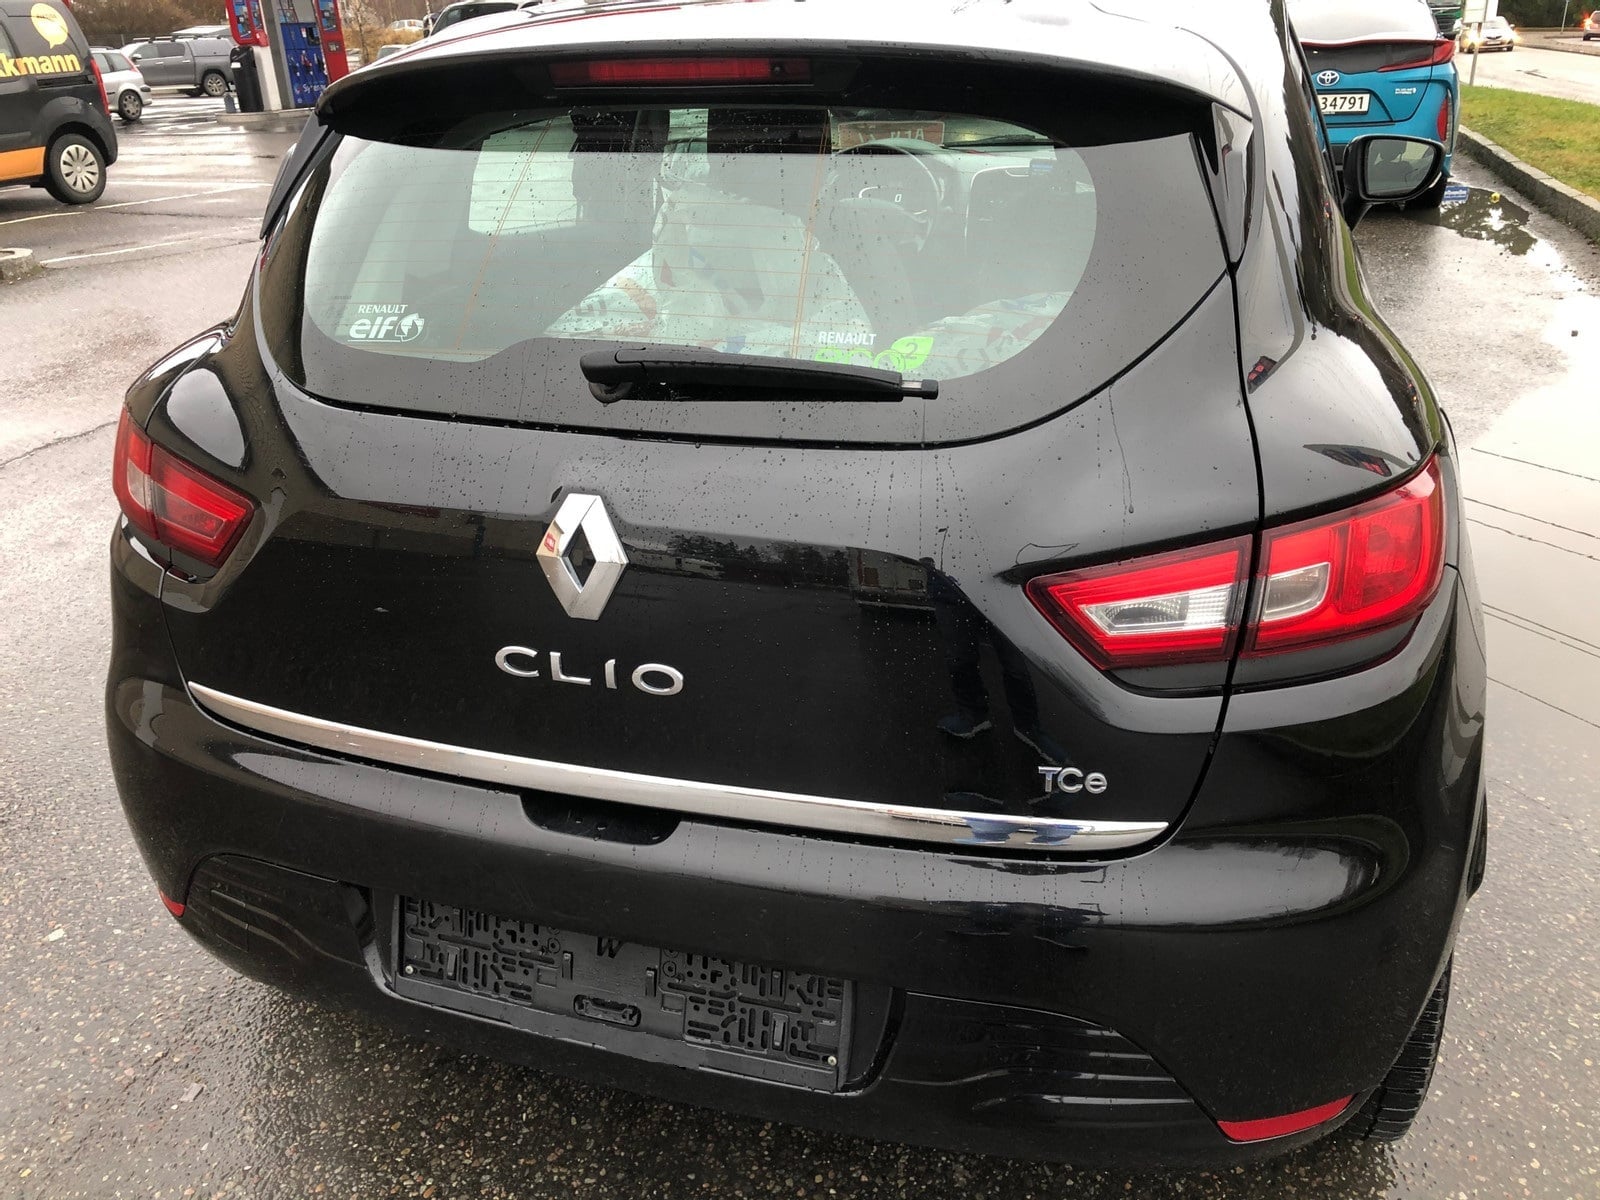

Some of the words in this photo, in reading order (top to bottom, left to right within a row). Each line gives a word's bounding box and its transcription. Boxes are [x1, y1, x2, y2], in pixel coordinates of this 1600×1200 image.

[0, 53, 81, 77] kmann
[1320, 96, 1364, 111] 34791
[358, 304, 408, 314] RENAULT
[349, 316, 398, 339] elf
[819, 331, 877, 346] RENAULT
[494, 645, 684, 696] CLIO
[1038, 766, 1108, 794] TCe
